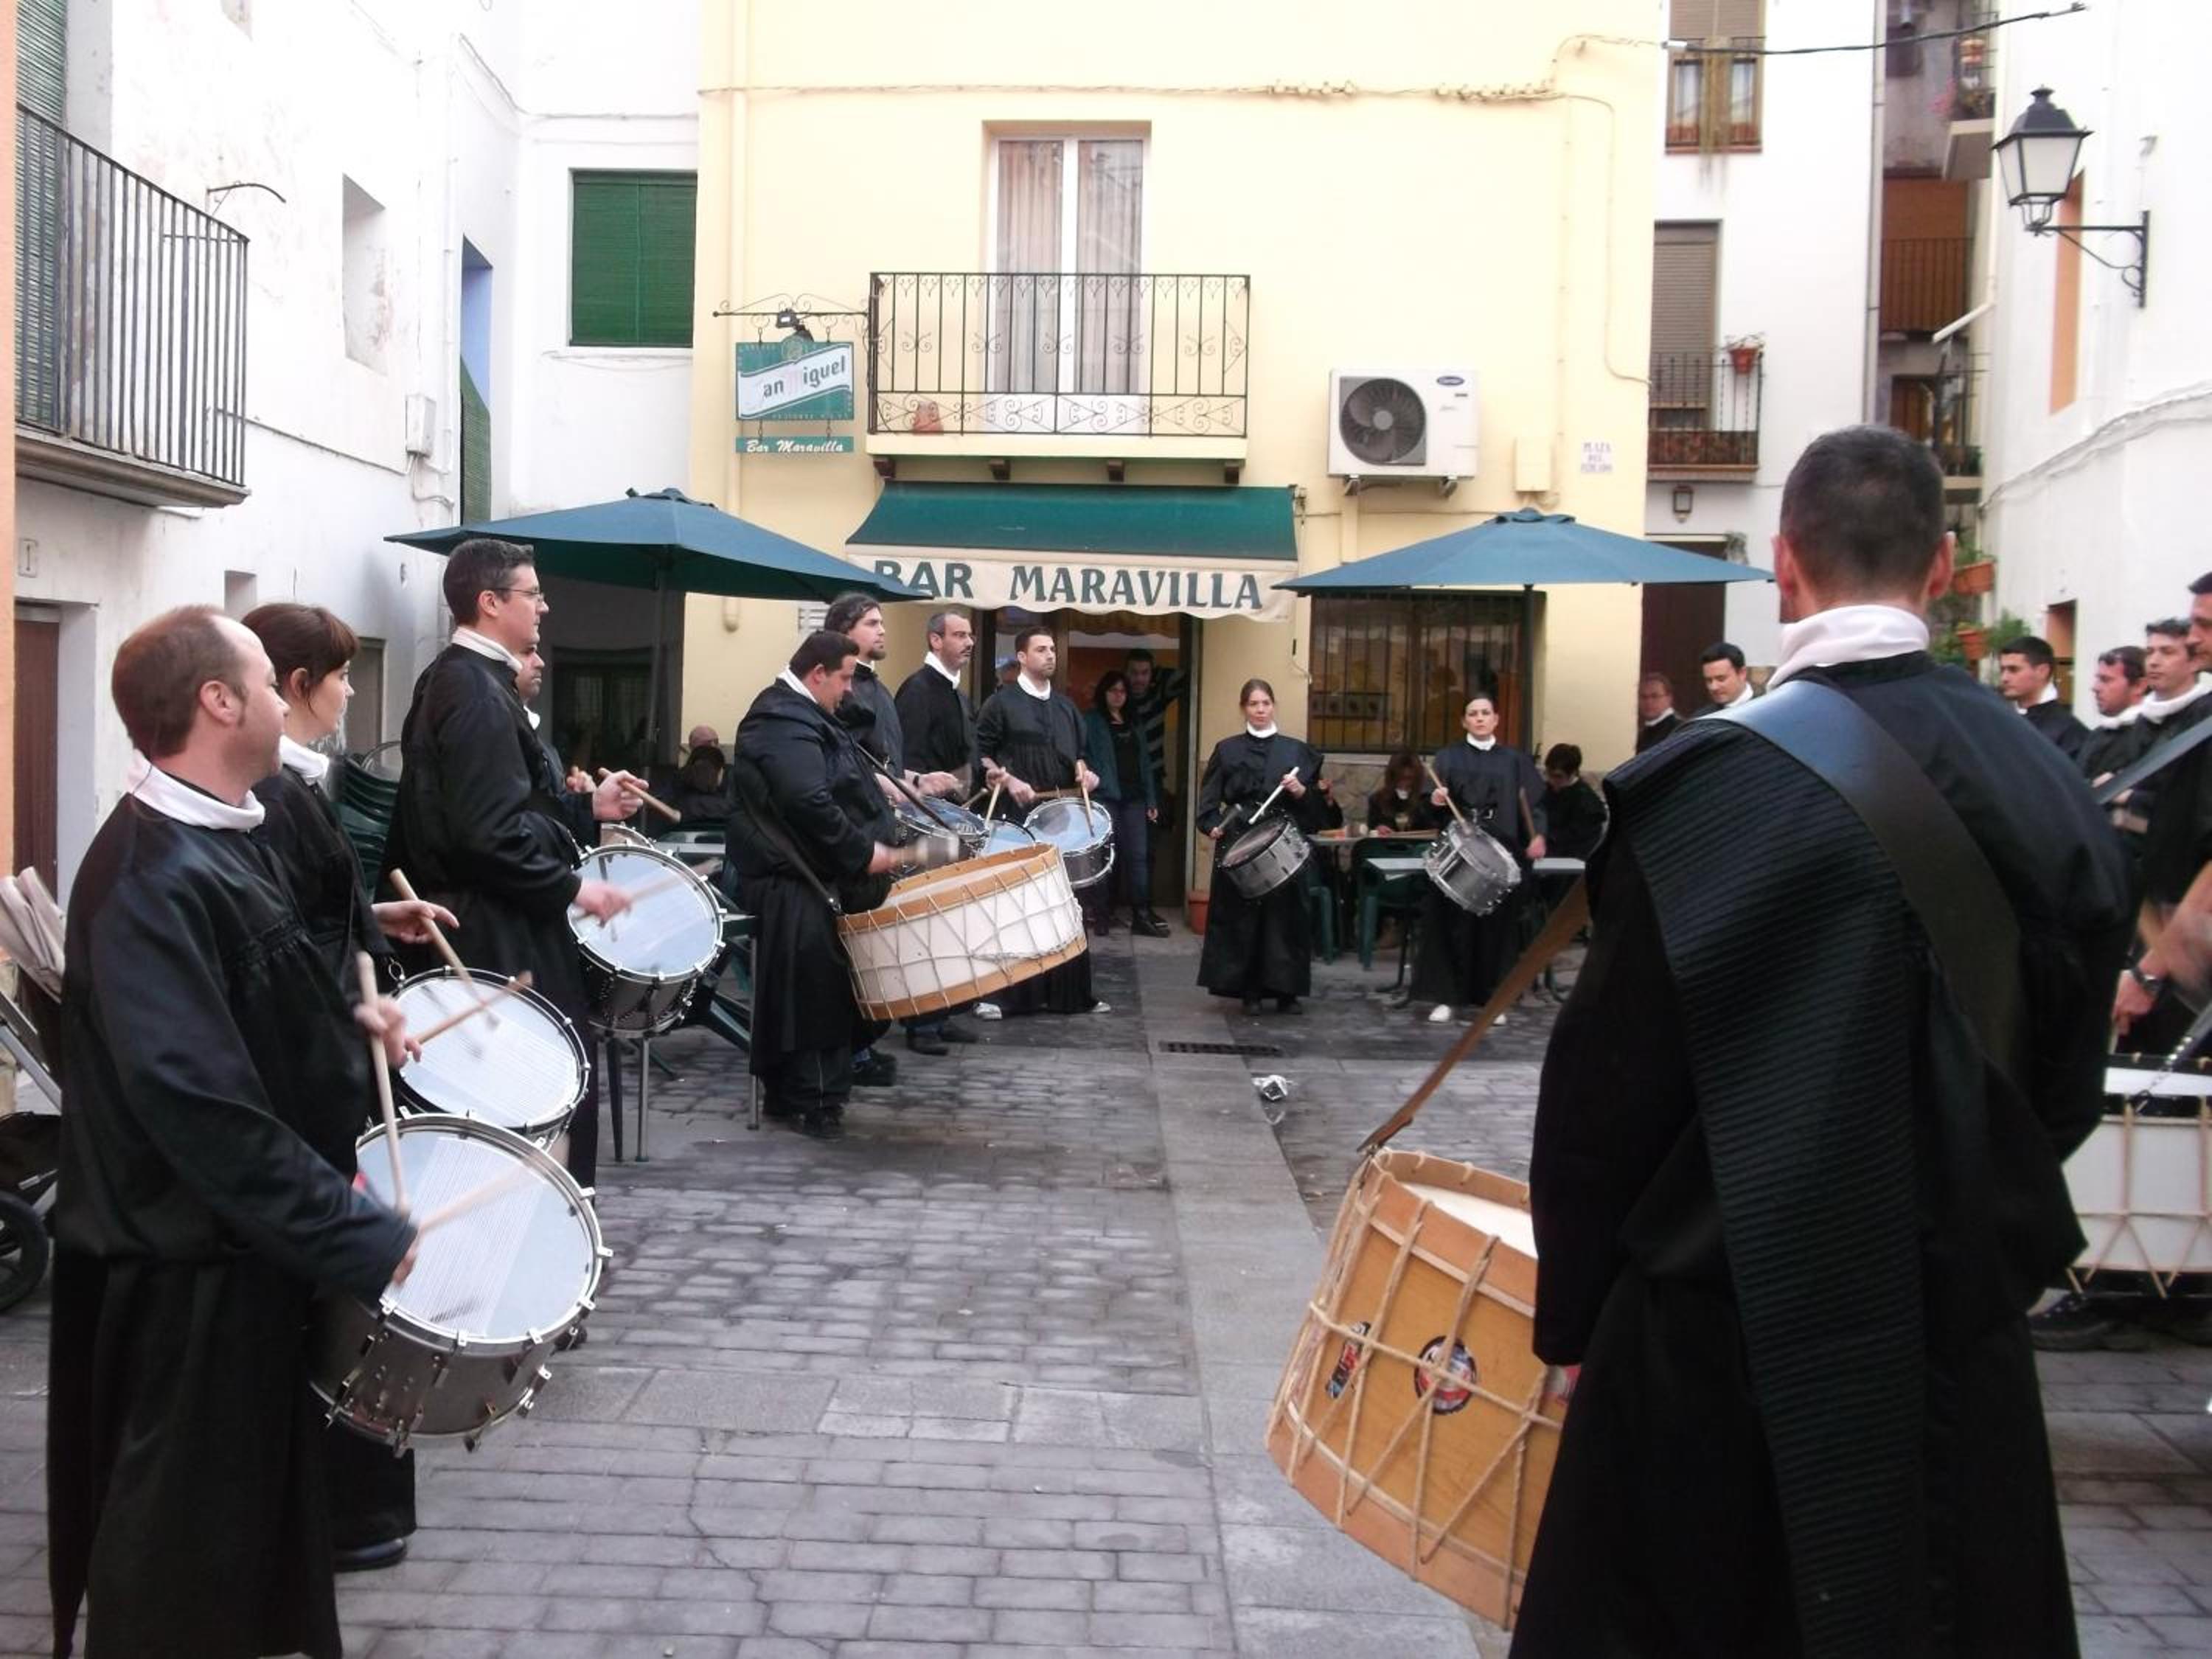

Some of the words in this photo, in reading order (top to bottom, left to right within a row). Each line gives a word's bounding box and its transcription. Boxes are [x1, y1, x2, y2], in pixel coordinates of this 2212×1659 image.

[746, 439, 769, 453] Bar
[776, 440, 844, 453] Maravilla
[875, 560, 973, 599] BAR
[1009, 566, 1263, 610] MARAVILLA
